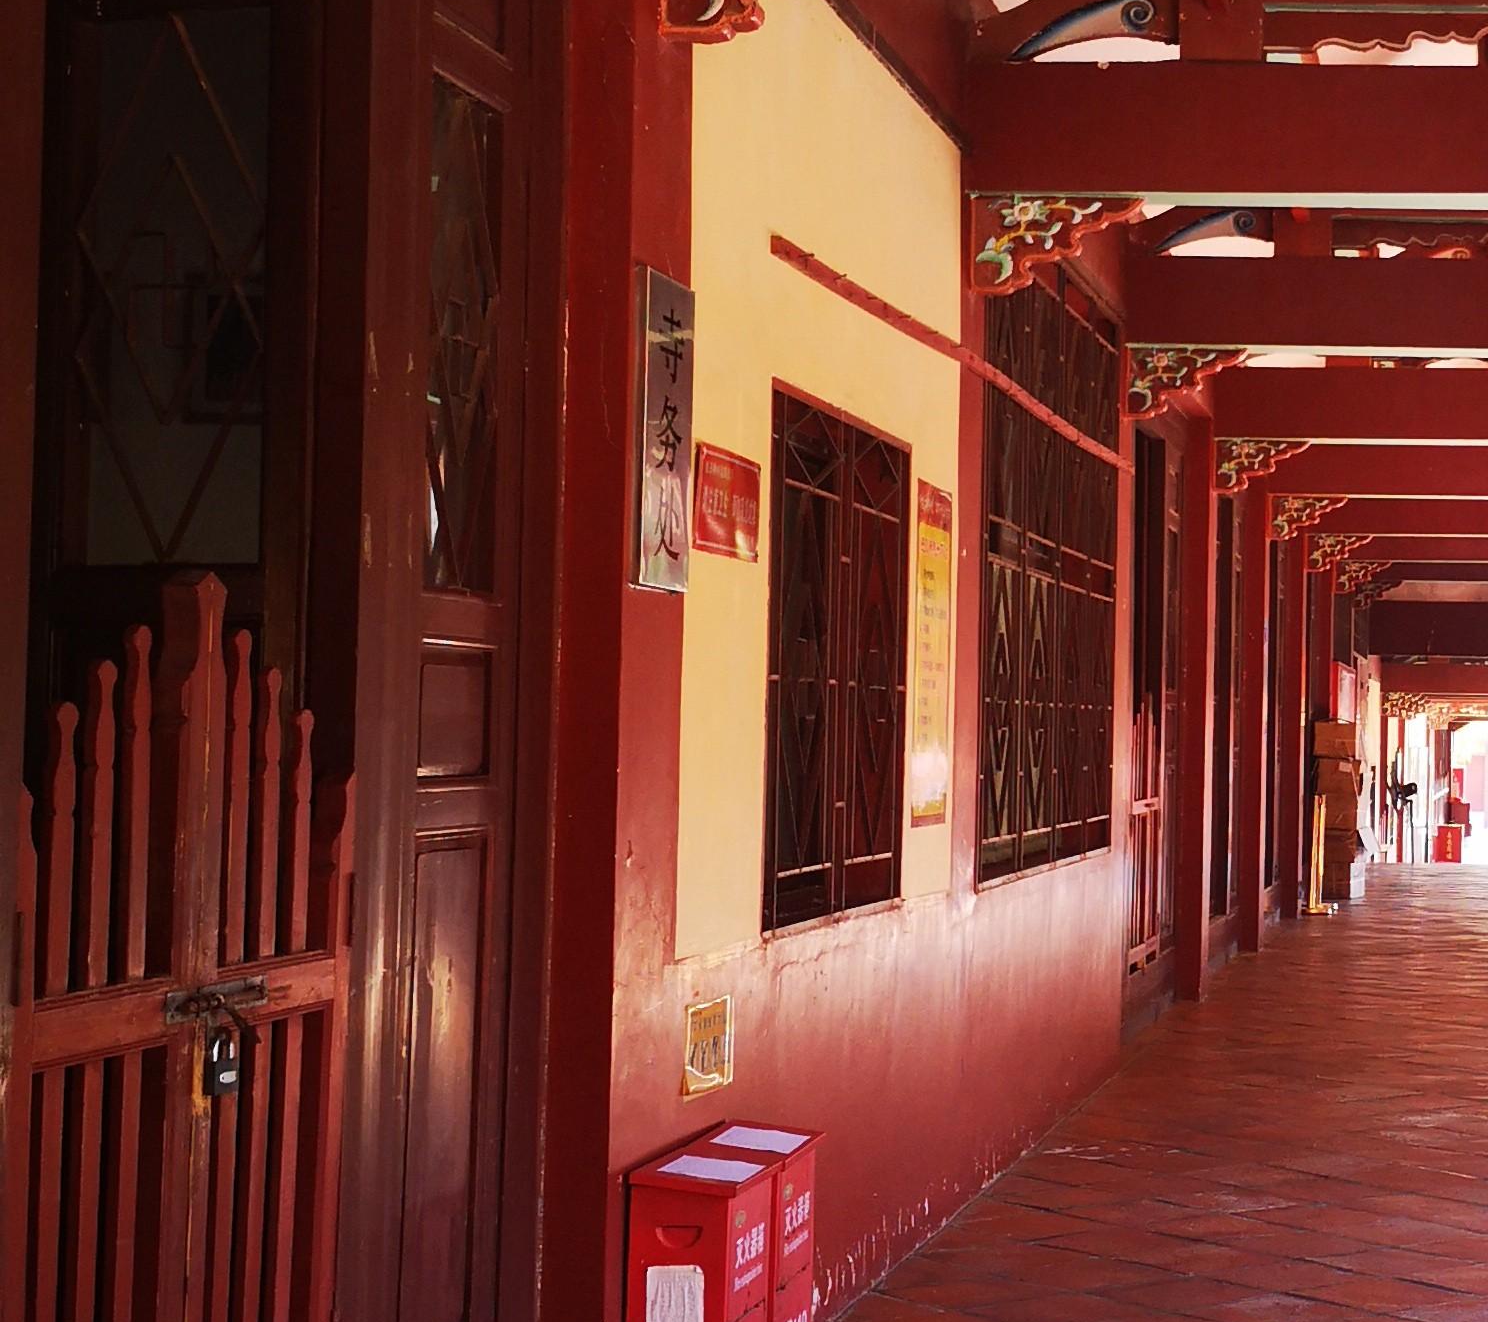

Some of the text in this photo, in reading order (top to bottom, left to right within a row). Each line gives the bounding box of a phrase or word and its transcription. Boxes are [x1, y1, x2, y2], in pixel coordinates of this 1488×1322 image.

[653, 308, 685, 561] 寺务处
[735, 1222, 765, 1270] 灭火器箱
